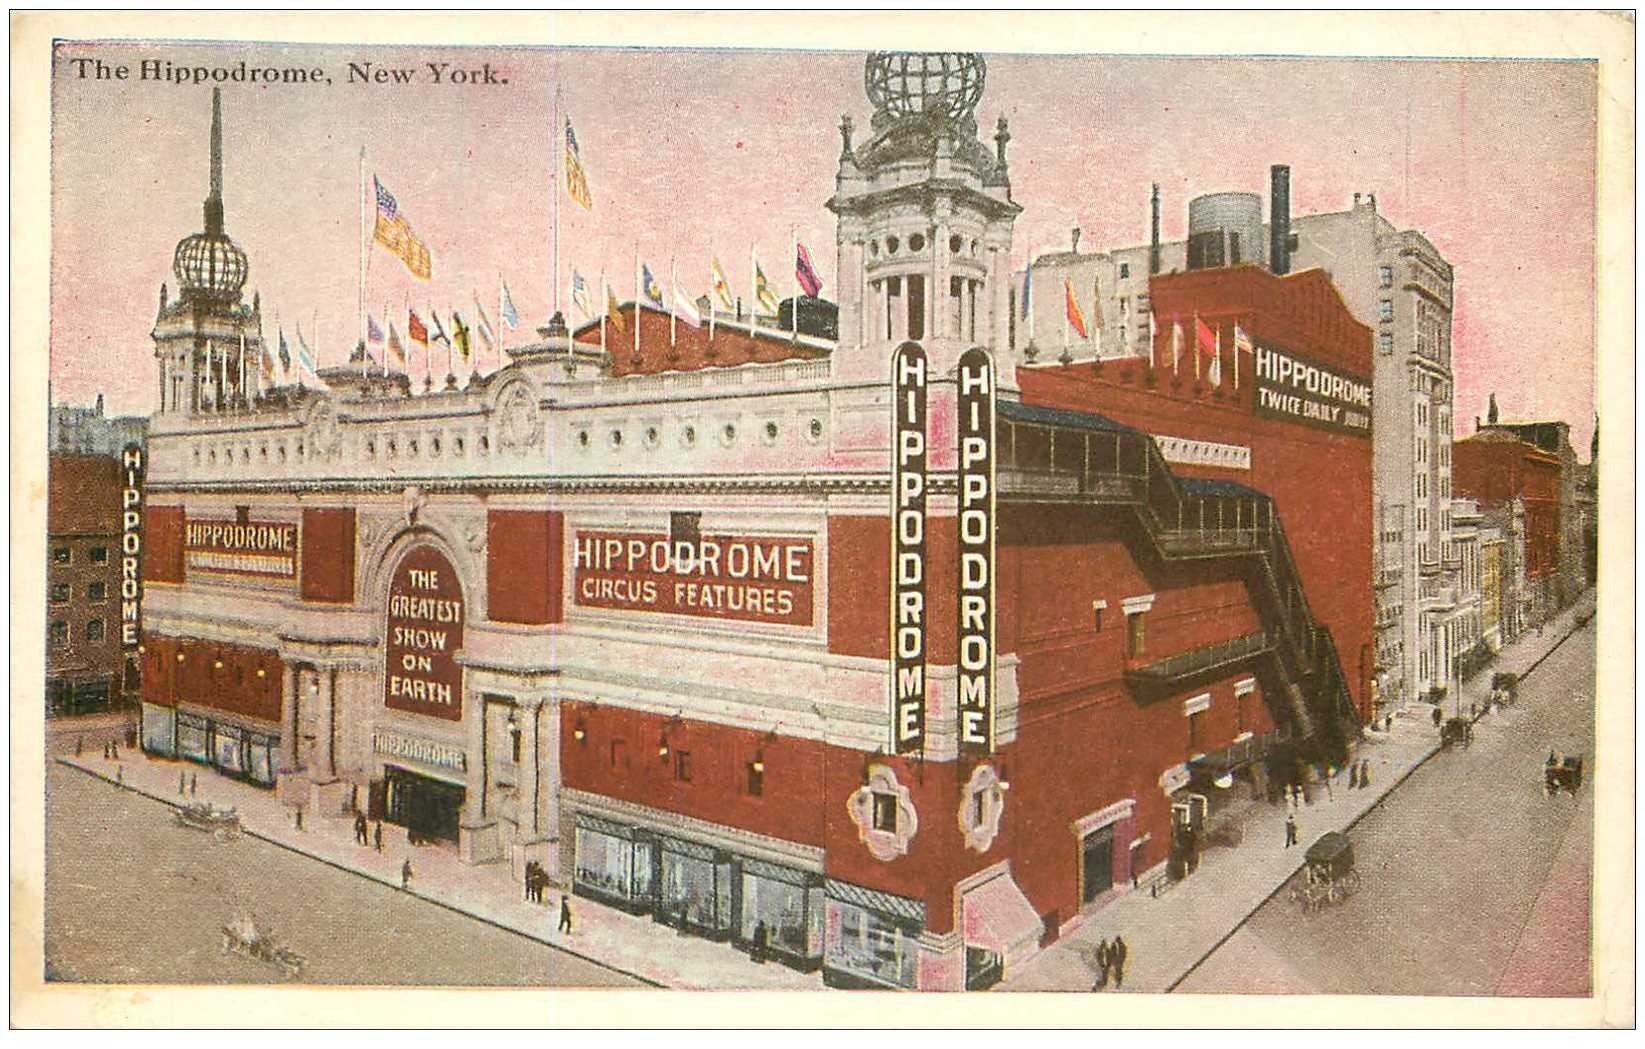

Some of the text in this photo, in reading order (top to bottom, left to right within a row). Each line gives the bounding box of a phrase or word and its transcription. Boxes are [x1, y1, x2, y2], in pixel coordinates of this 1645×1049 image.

[1256, 347, 1372, 407] HIPPODROME
[1259, 387, 1301, 415] TWICE
[1303, 400, 1341, 422] DAILY
[186, 523, 296, 551] HIPPODROME
[899, 355, 925, 741] HIPPODROME
[574, 537, 809, 582] HIPPODROME
[961, 365, 988, 745] HIPPODROME
[409, 570, 438, 590] THE
[582, 577, 793, 615] CIRCUS FEATURES
[391, 594, 461, 624] GREATEST
[394, 627, 447, 650] SHOW
[402, 654, 432, 672] ON
[390, 675, 451, 705] EARTH
